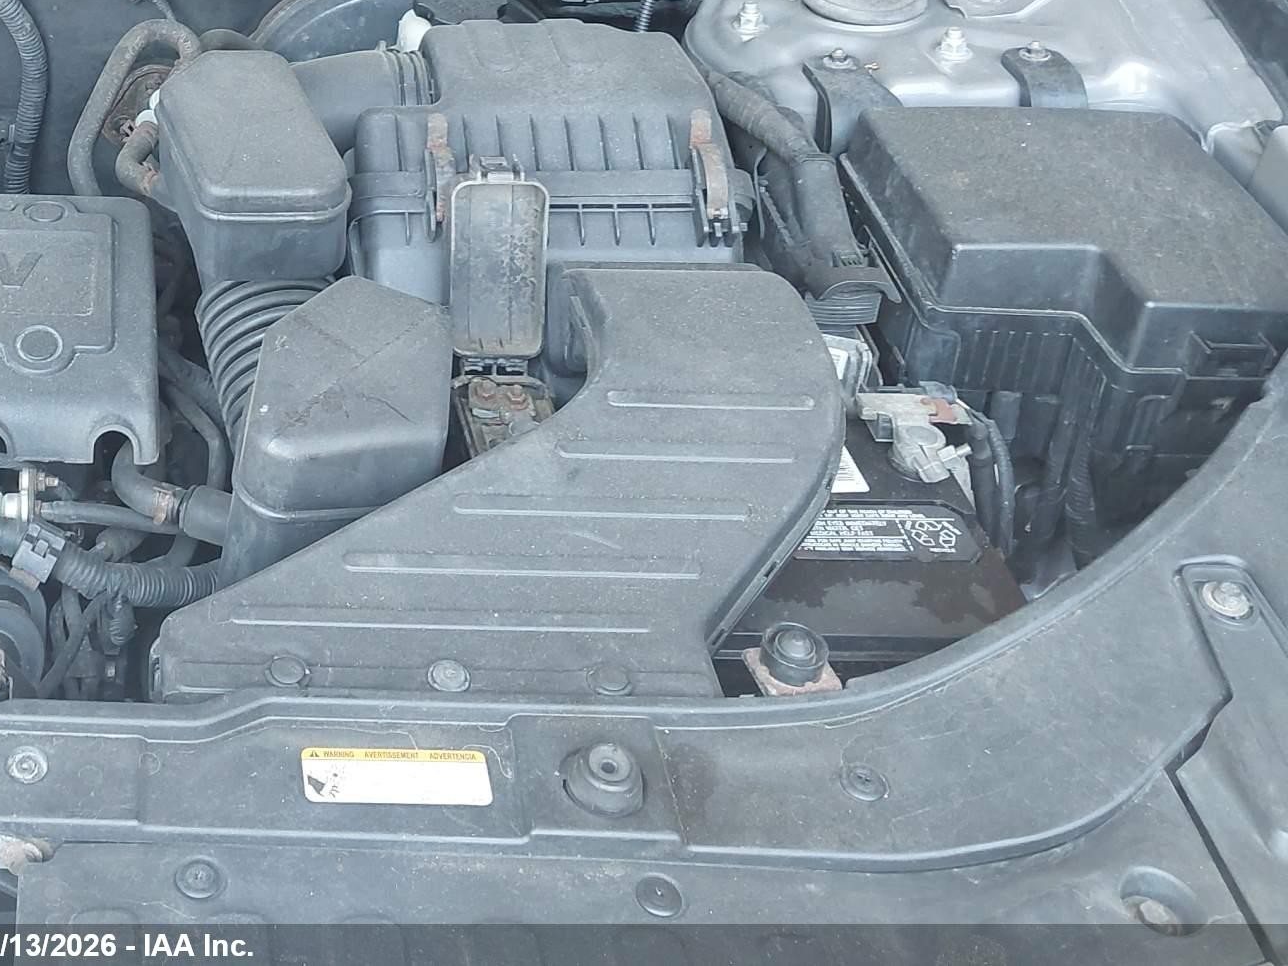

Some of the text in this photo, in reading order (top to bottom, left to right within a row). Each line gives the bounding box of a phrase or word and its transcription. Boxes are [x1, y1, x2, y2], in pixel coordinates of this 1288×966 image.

[323, 750, 476, 761] WARNING AVERTISSEMENT ADVERTENCIA
